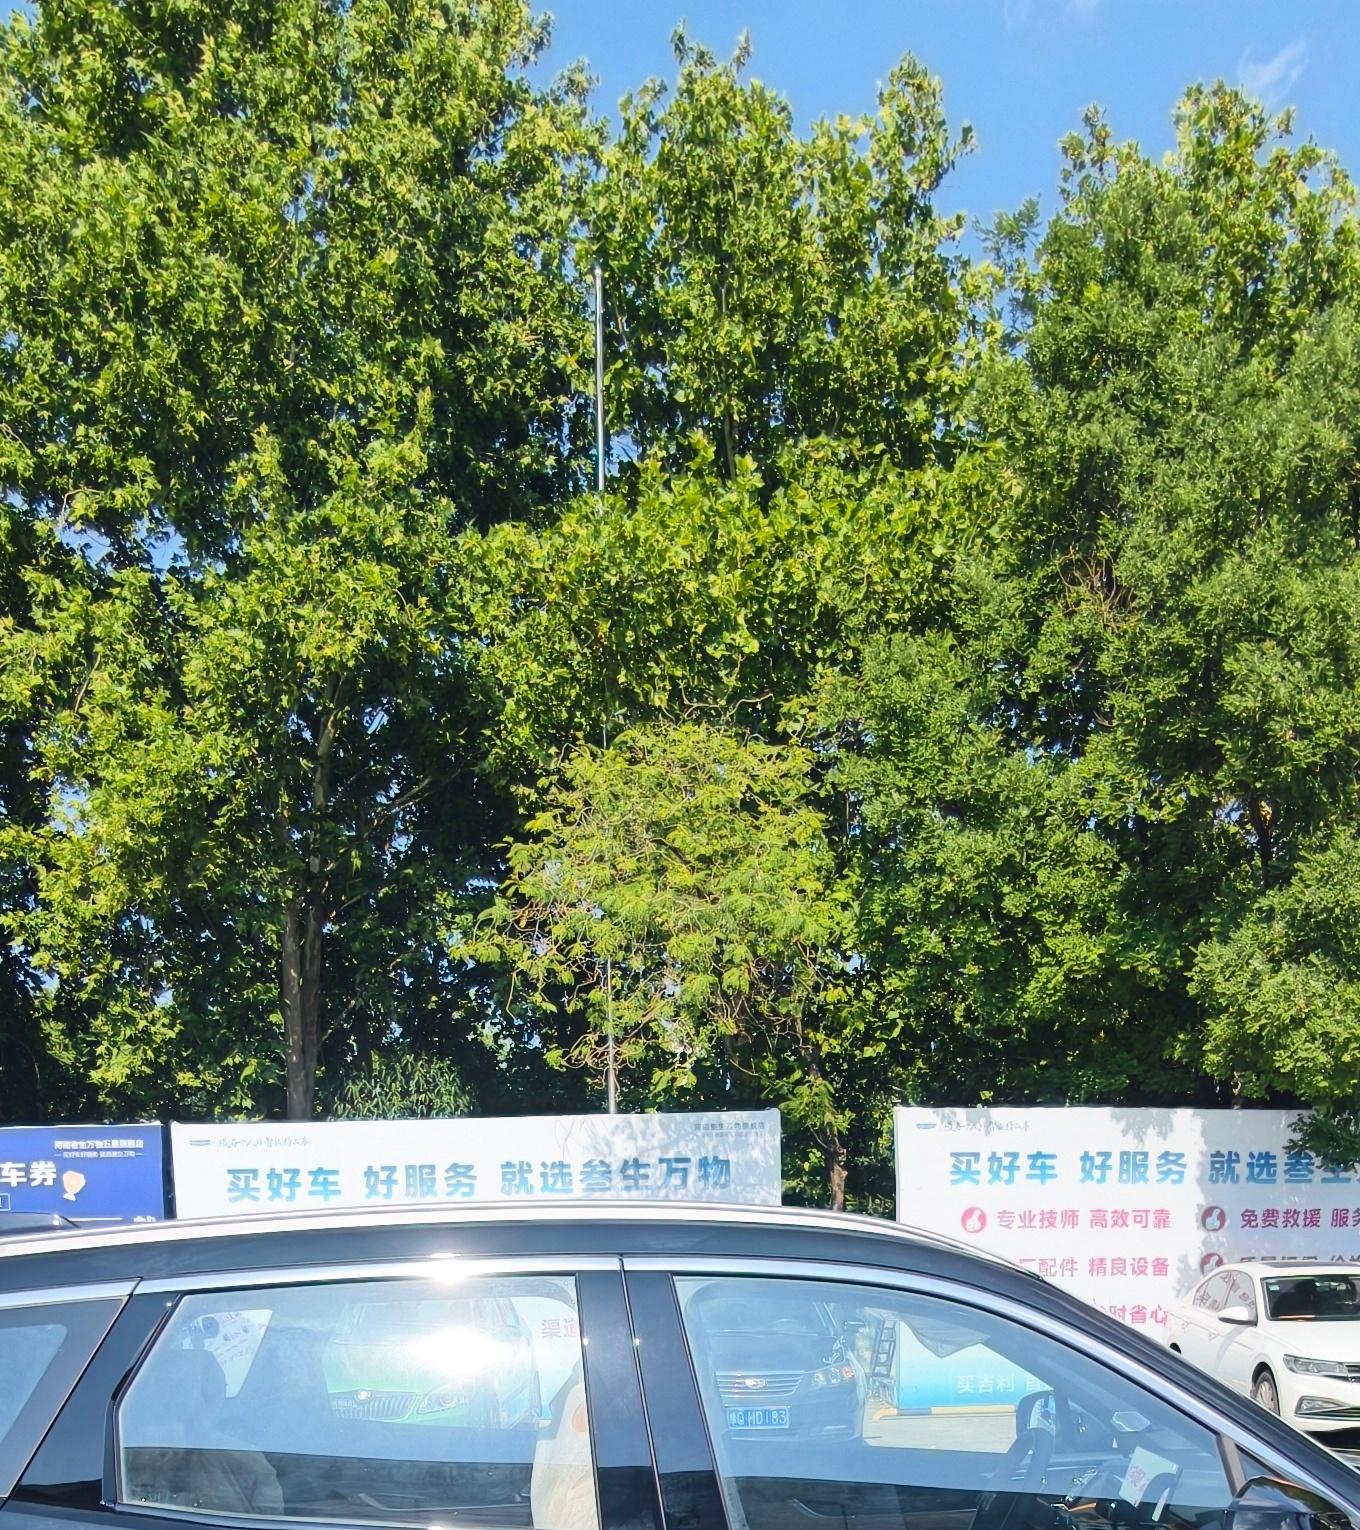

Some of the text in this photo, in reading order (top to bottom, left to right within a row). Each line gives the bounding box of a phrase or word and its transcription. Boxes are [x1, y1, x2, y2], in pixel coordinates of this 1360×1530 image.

[949, 1151, 1058, 1186] 买好车
[1079, 1150, 1188, 1185] 好服务
[226, 1156, 731, 1203] 买好车 好服务 就选叁生万物
[997, 1208, 1172, 1230] 专业技师 高效可靠
[1240, 1208, 1321, 1229] 免费救援
[1088, 1257, 1169, 1278] 精良设备
[1101, 1303, 1169, 1327] 时省心
[957, 1374, 1015, 1393] 买吉利
